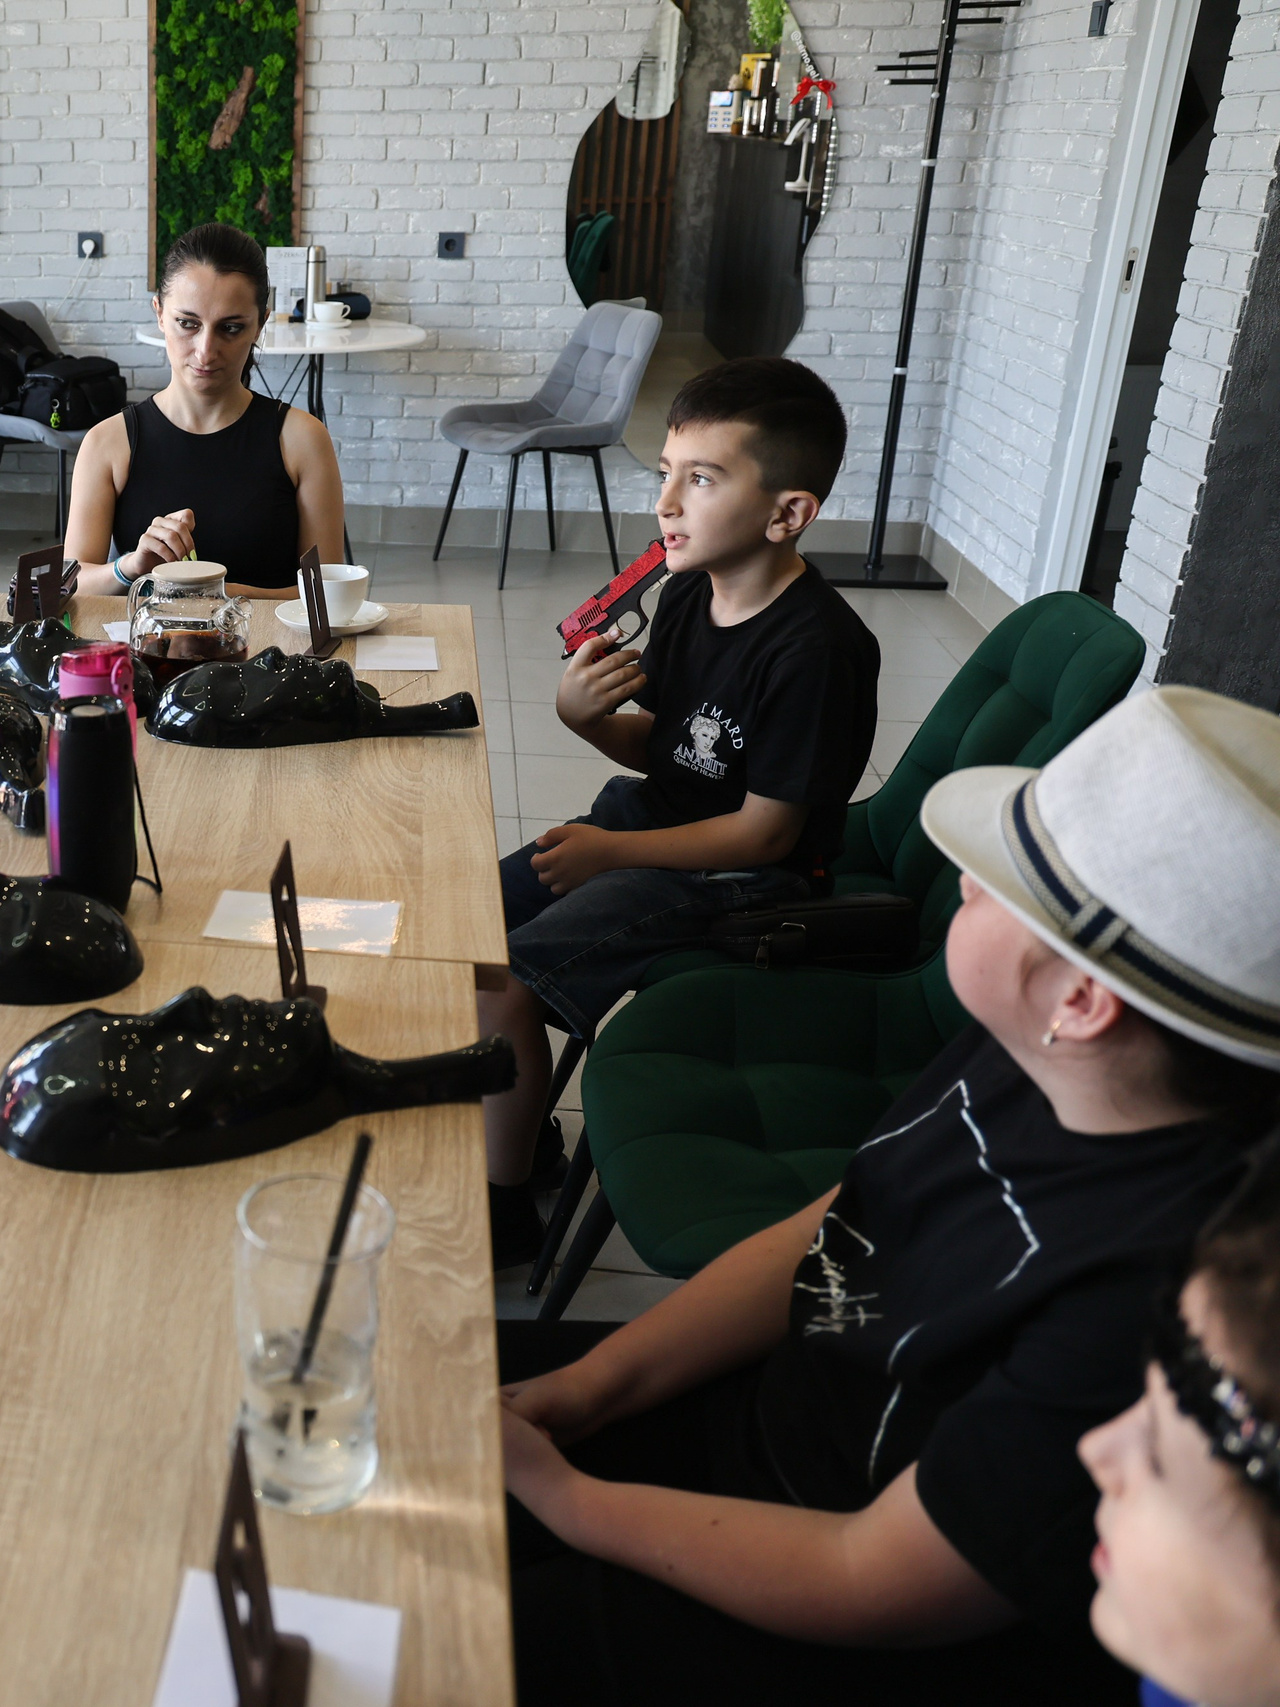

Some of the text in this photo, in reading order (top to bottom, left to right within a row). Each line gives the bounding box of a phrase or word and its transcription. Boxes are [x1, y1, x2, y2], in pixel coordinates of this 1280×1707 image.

[710, 705, 744, 750] MARD
[673, 743, 728, 776] ANAHIT
[690, 764, 700, 772] OF
